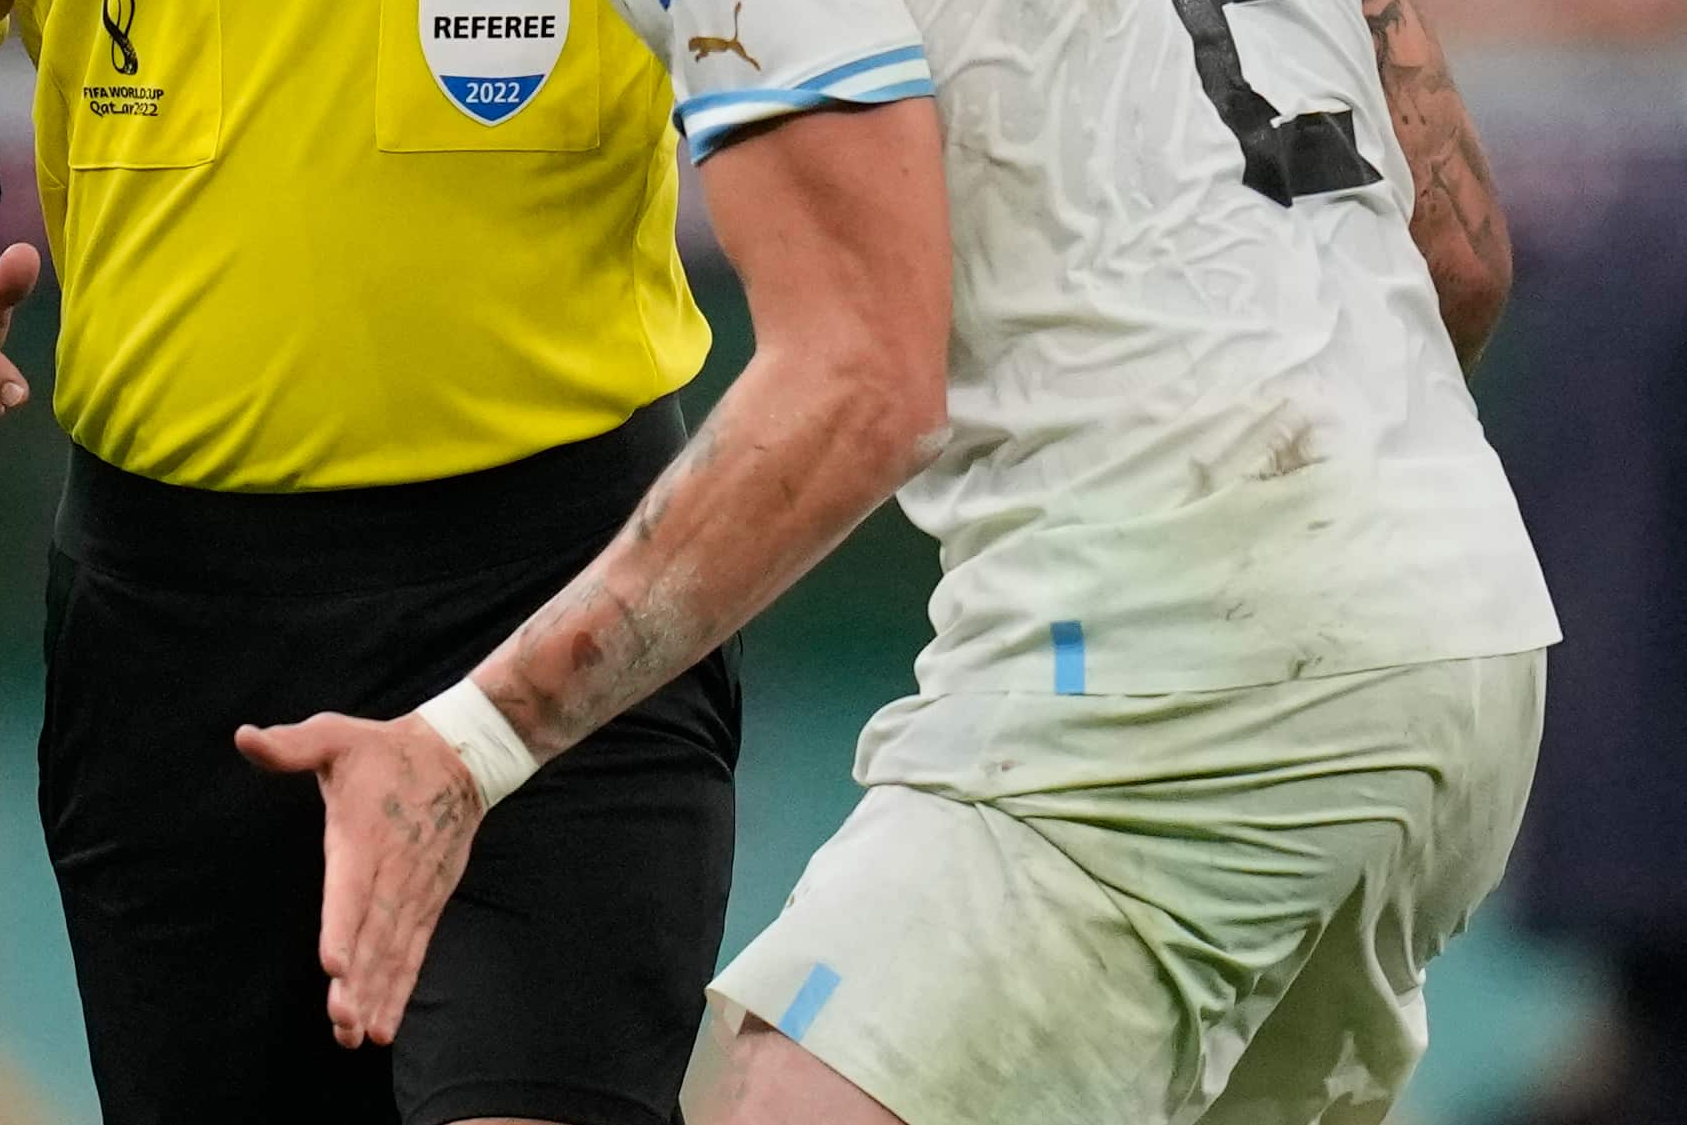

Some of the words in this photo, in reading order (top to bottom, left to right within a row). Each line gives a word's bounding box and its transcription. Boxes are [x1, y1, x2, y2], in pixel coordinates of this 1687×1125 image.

[434, 15, 556, 39] REFEREE
[83, 87, 107, 99] FIFA
[465, 82, 520, 104] 2022
